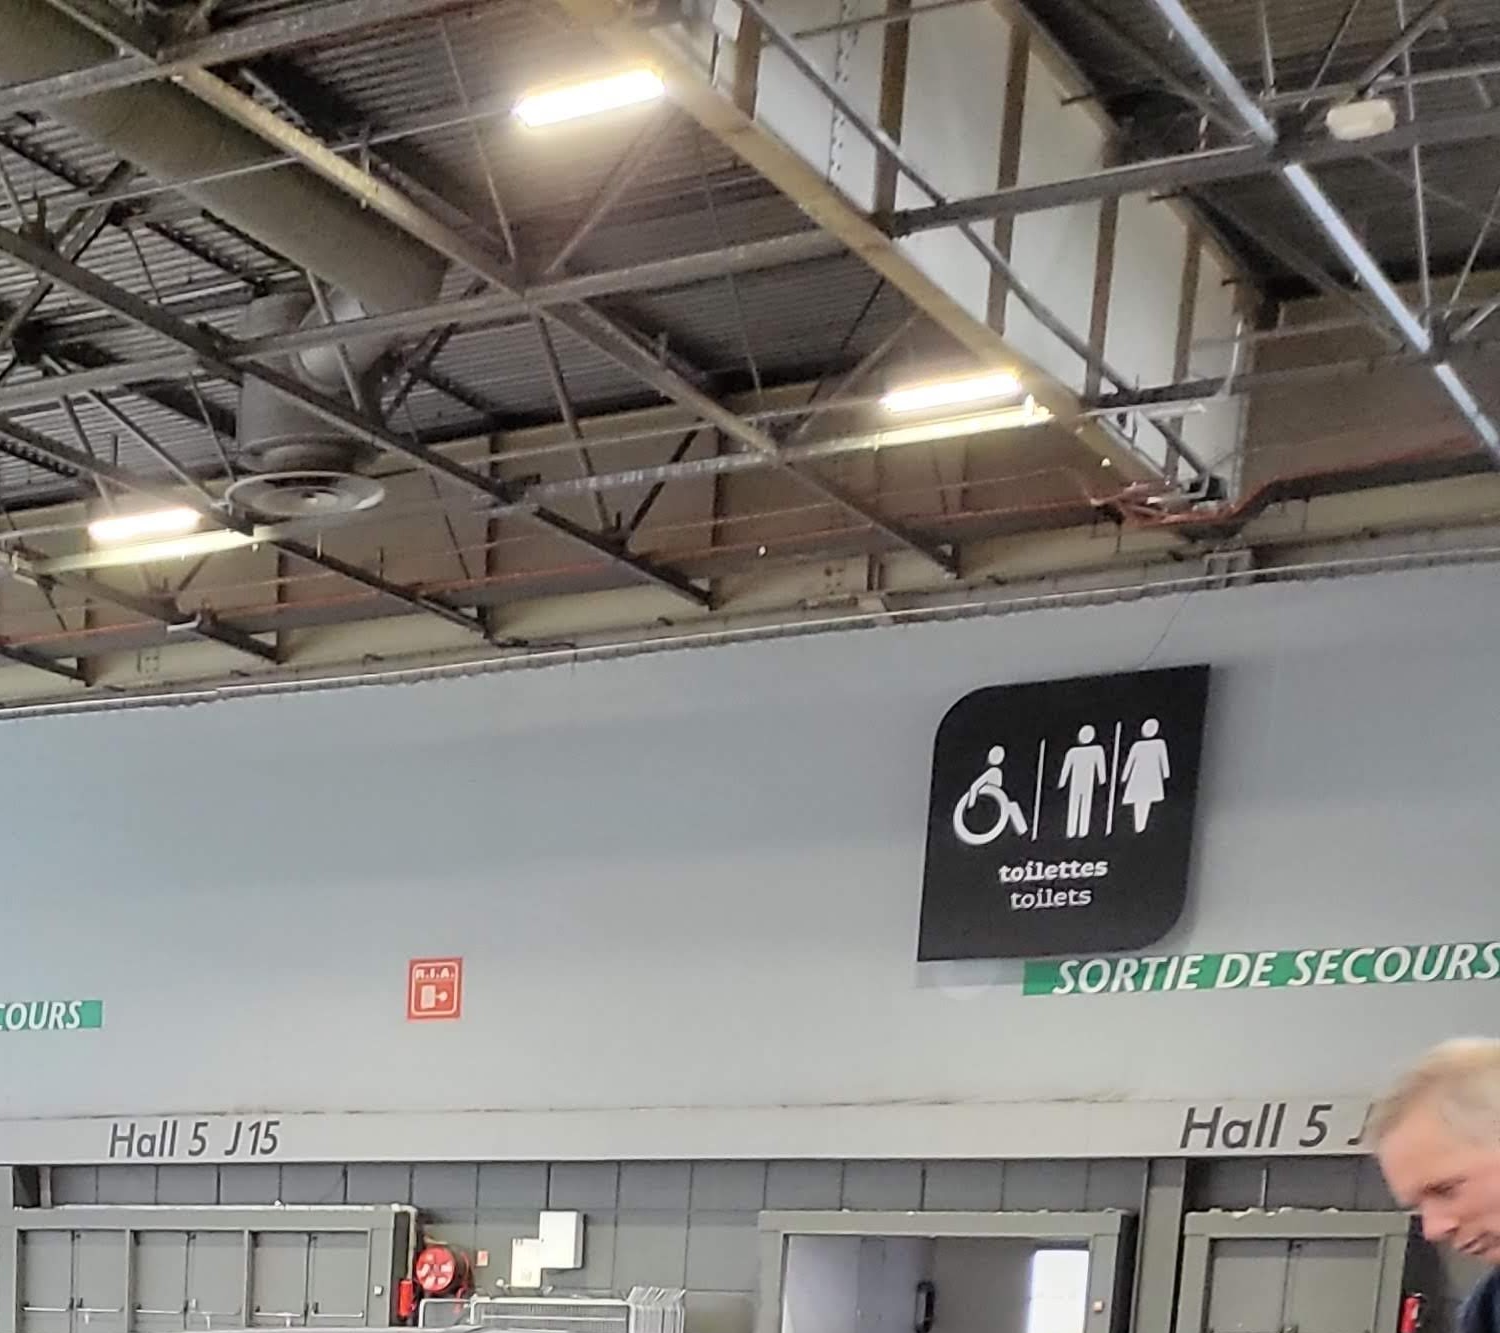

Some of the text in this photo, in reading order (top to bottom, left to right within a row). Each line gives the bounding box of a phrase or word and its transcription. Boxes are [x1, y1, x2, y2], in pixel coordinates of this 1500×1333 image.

[998, 860, 1108, 883] toilettes
[1010, 887, 1092, 910] toilets
[1052, 942, 1500, 995] SORTIE DE SECOURS
[109, 1119, 178, 1158] Hall
[187, 1121, 209, 1157] 5
[1179, 1102, 1287, 1149] Hall
[1298, 1103, 1334, 1148] 5
